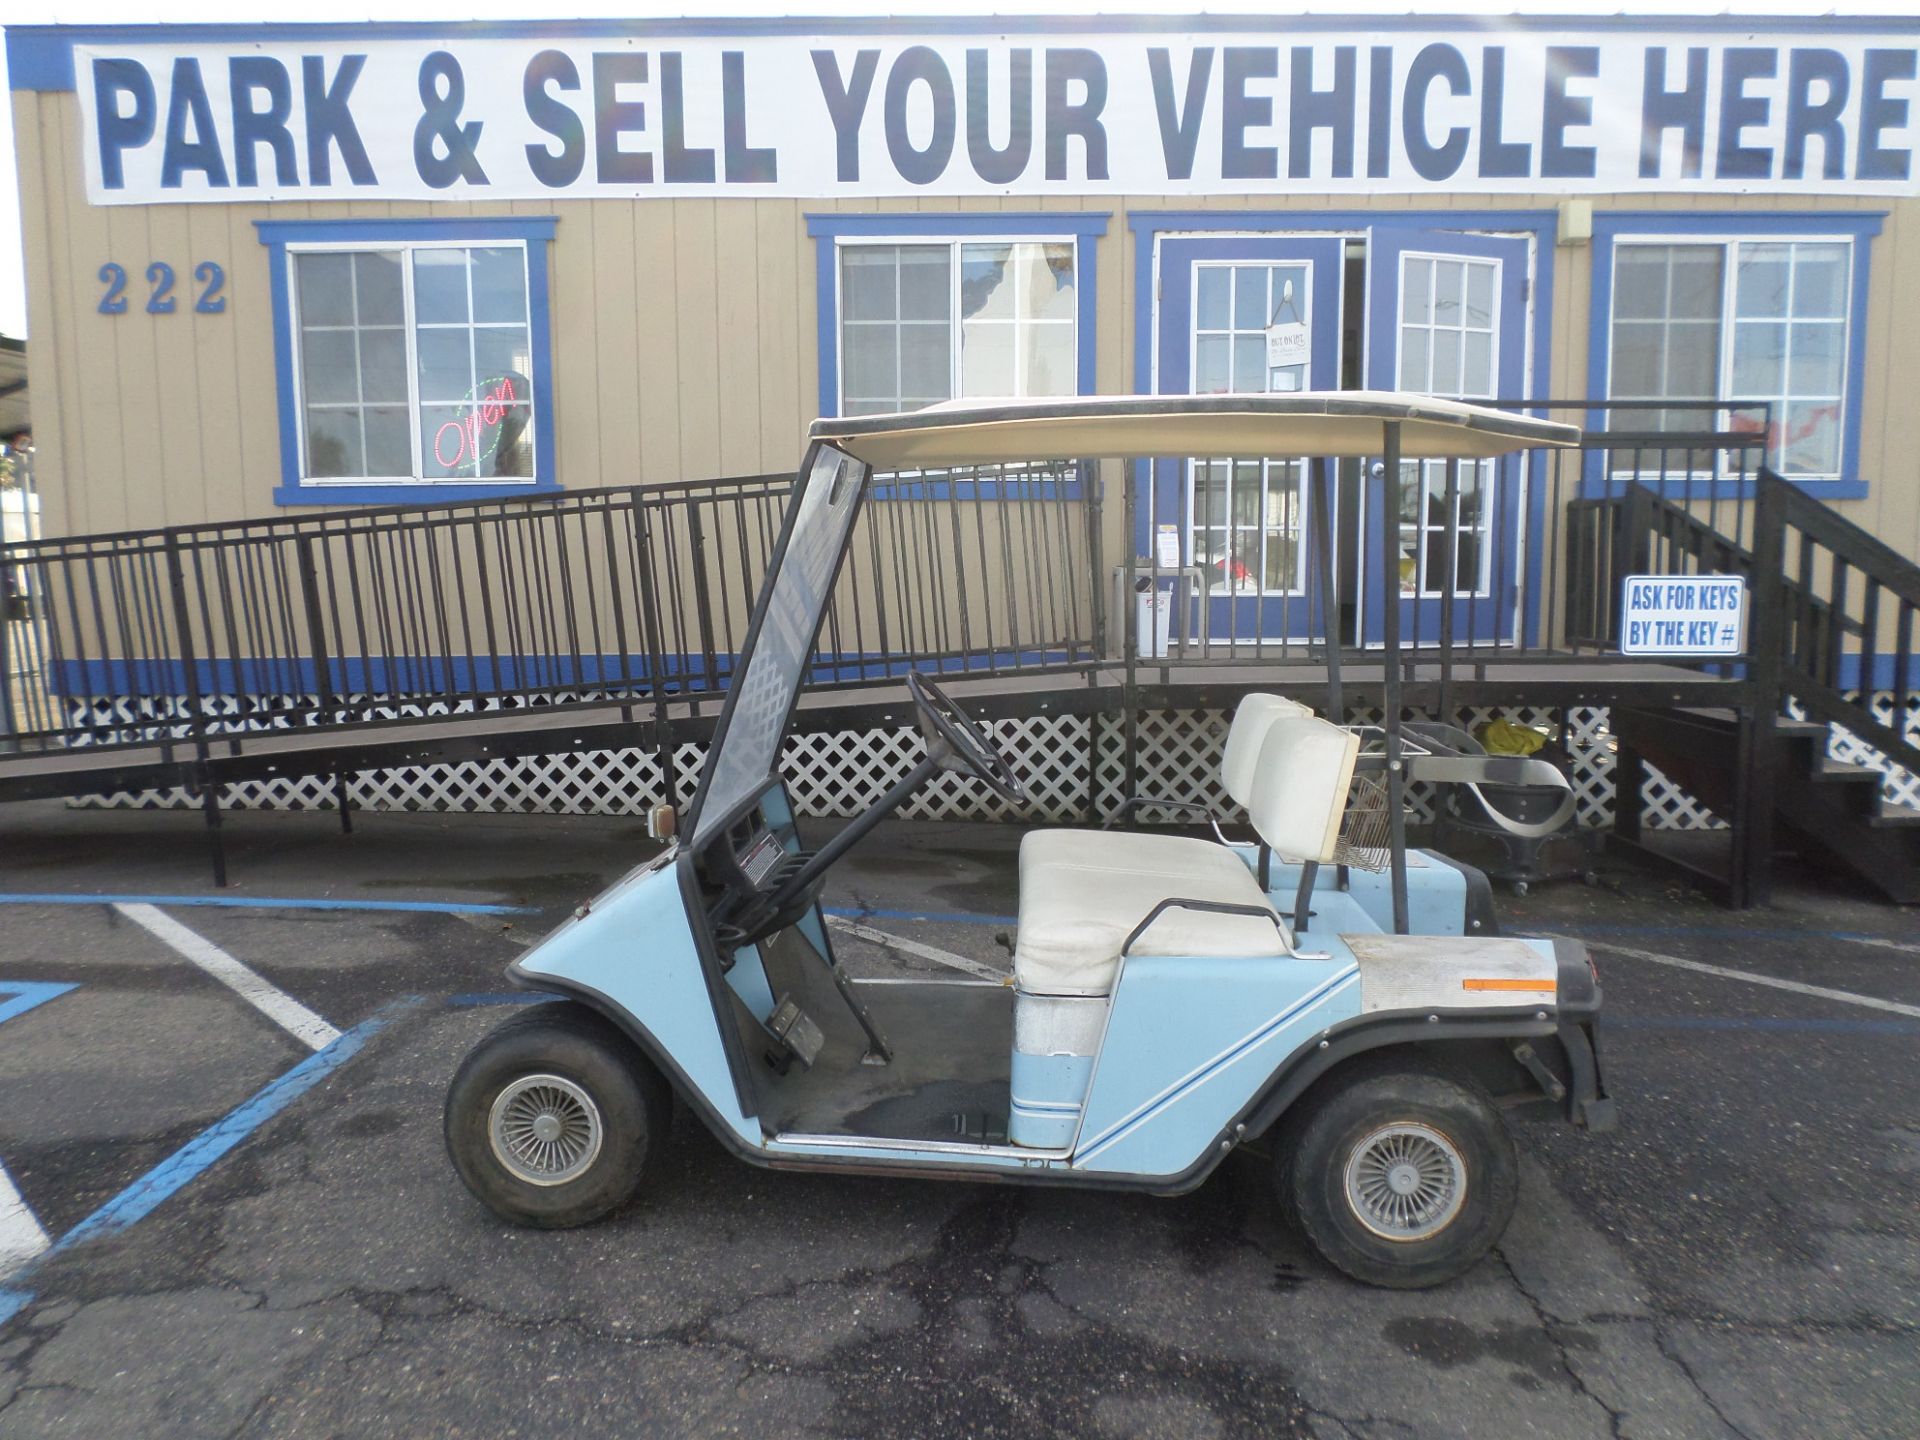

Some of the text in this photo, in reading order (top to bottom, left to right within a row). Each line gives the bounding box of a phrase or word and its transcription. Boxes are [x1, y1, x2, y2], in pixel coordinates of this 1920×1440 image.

[92, 42, 1918, 190] PARK & SELL YOUR VEHICLE HERE
[97, 260, 226, 315] 222
[434, 377, 517, 468] Open
[1631, 584, 1738, 610] ASK FOR KEYS
[1630, 621, 1735, 646] BY THE KEY #
